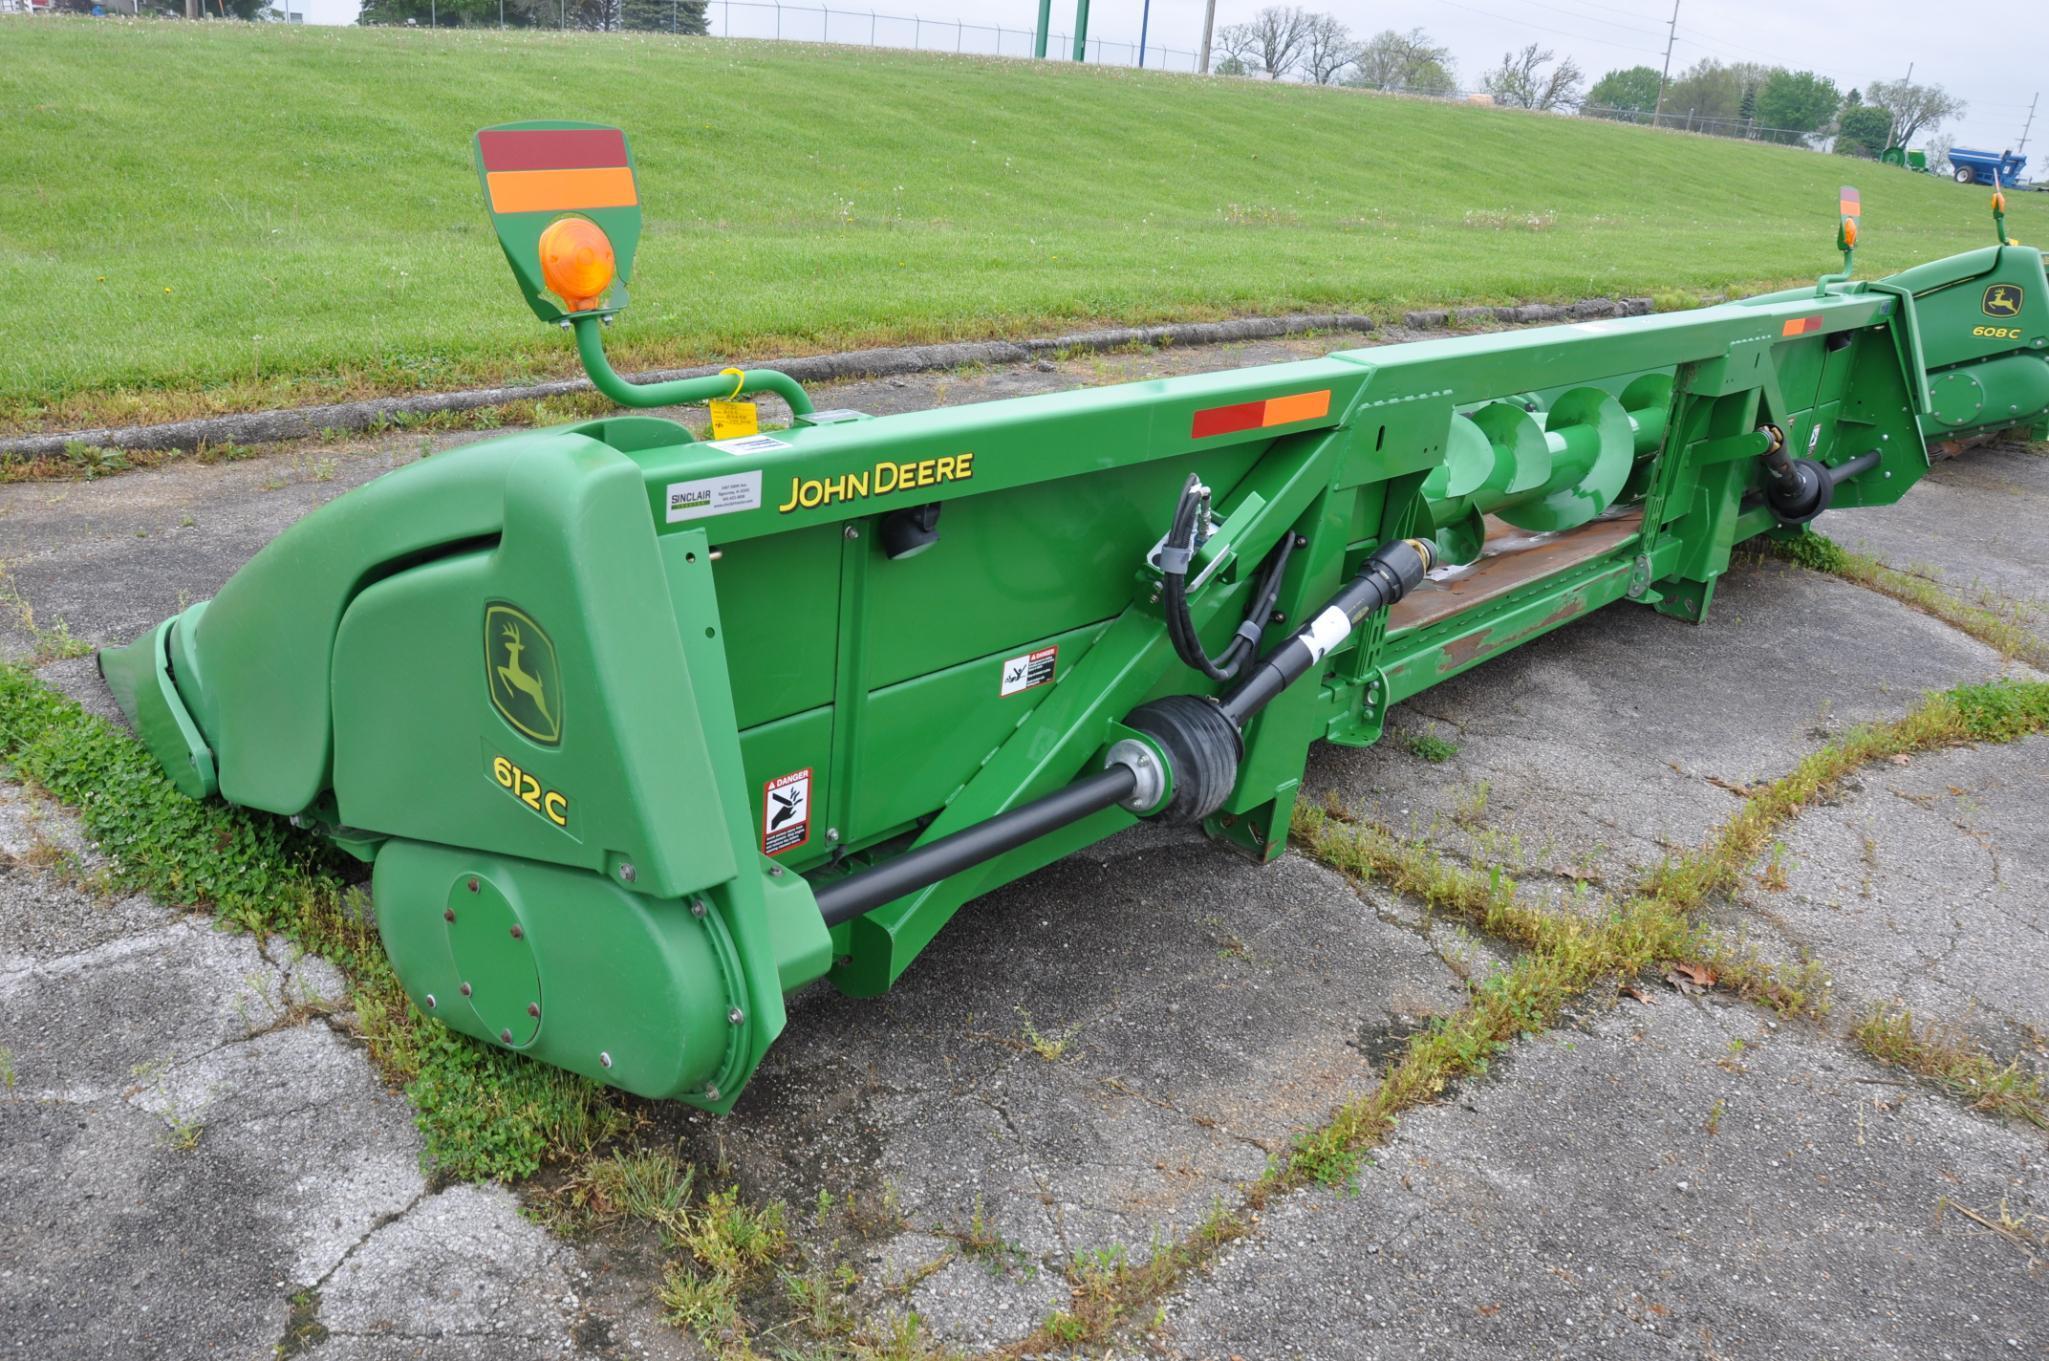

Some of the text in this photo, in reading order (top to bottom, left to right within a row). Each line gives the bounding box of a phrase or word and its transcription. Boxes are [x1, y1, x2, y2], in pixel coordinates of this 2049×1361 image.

[779, 452, 974, 513] JOHN DEERE
[671, 489, 711, 504] SINCLAIR
[776, 769, 809, 788] DANGER
